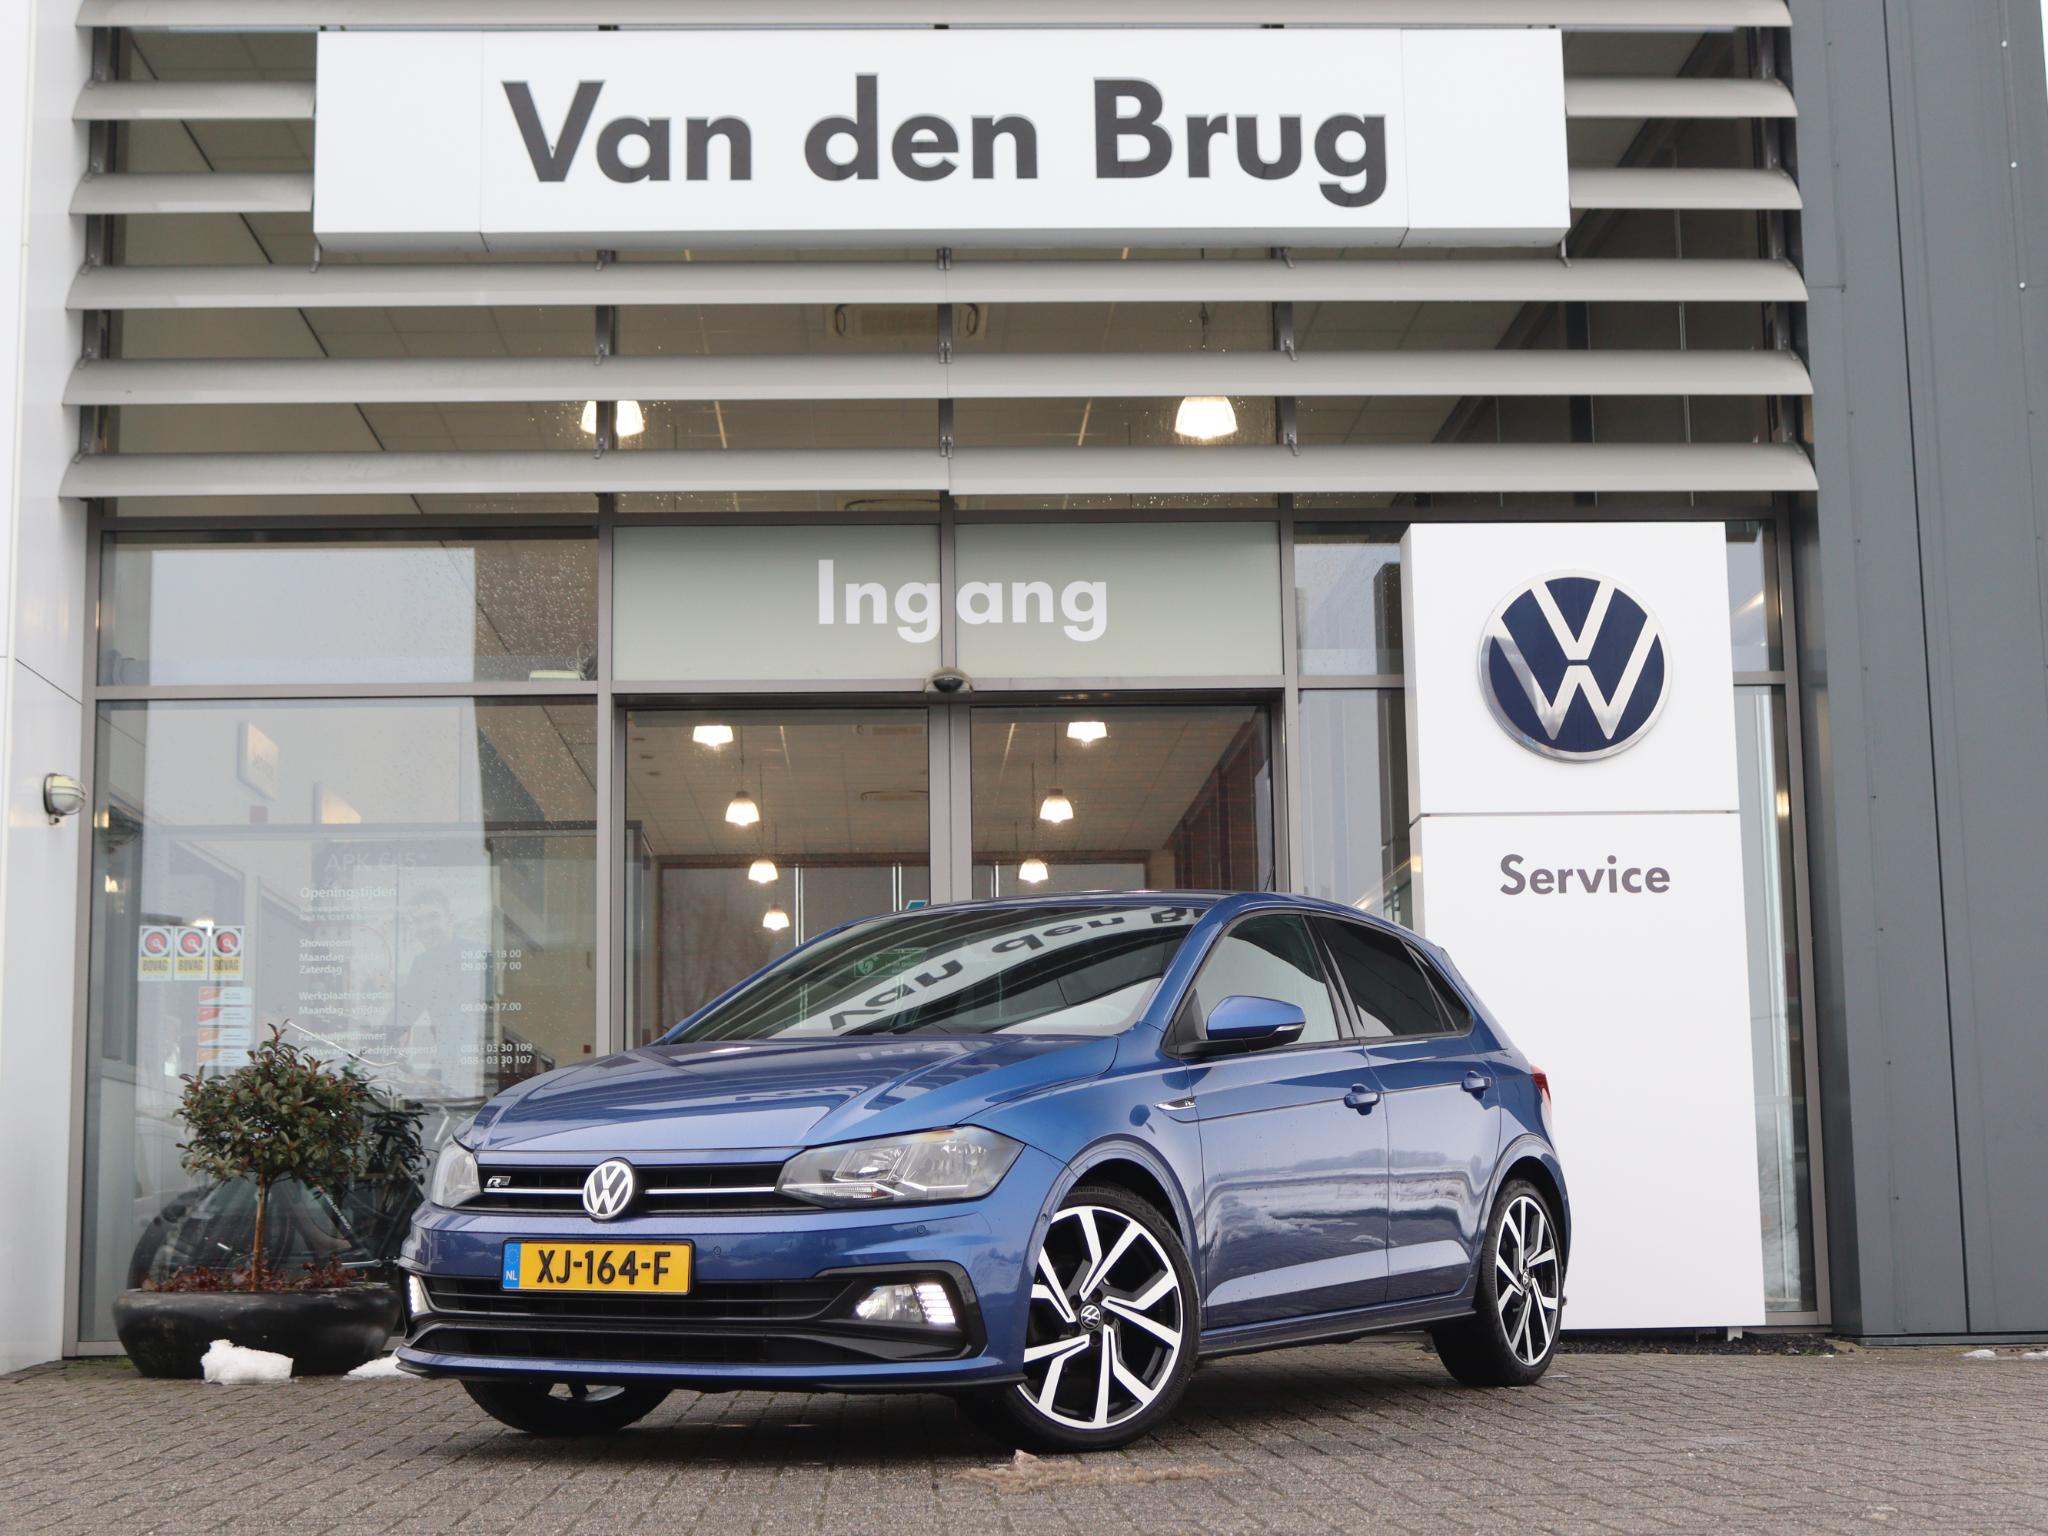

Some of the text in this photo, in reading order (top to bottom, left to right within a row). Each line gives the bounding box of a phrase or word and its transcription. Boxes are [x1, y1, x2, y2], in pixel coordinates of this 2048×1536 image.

[500, 71, 1388, 208] Van den Brug
[818, 559, 1107, 643] Ingang
[324, 853, 369, 872] APK
[1500, 854, 1670, 896] Service
[300, 886, 397, 901] Openingstijden
[298, 953, 344, 964] Maandag
[299, 965, 343, 976] Zaterdag
[298, 1005, 344, 1017] Maandag
[352, 1005, 385, 1017] vrijdag
[495, 1003, 521, 1011] 17.00
[486, 1044, 498, 1052] 03
[500, 1044, 513, 1052] 30
[515, 1043, 533, 1052] 109
[486, 1055, 498, 1064] 03
[500, 1055, 513, 1064] 30
[515, 1055, 533, 1064] 107
[536, 1249, 672, 1285] XJ-164-F
[505, 1269, 518, 1281] NL
